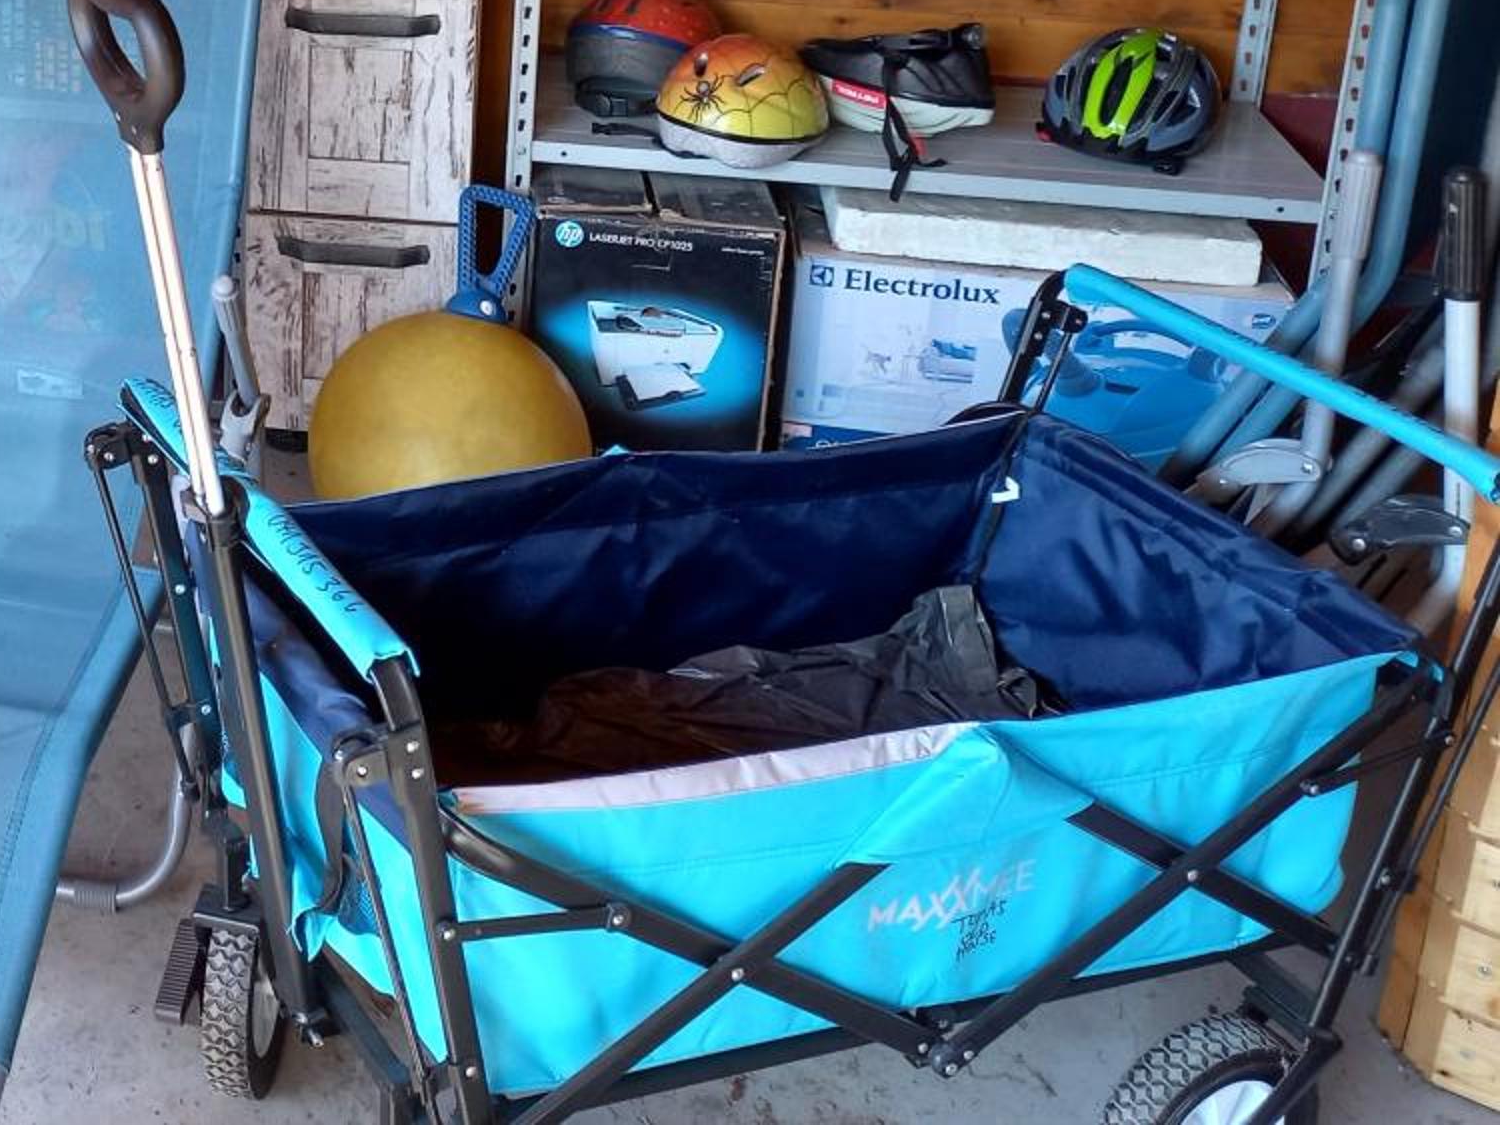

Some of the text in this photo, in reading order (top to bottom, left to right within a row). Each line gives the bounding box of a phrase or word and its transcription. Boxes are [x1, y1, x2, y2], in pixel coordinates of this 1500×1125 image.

[589, 233, 634, 246] LASERJET
[635, 236, 655, 248] PRO
[844, 268, 1001, 305] Electrolux
